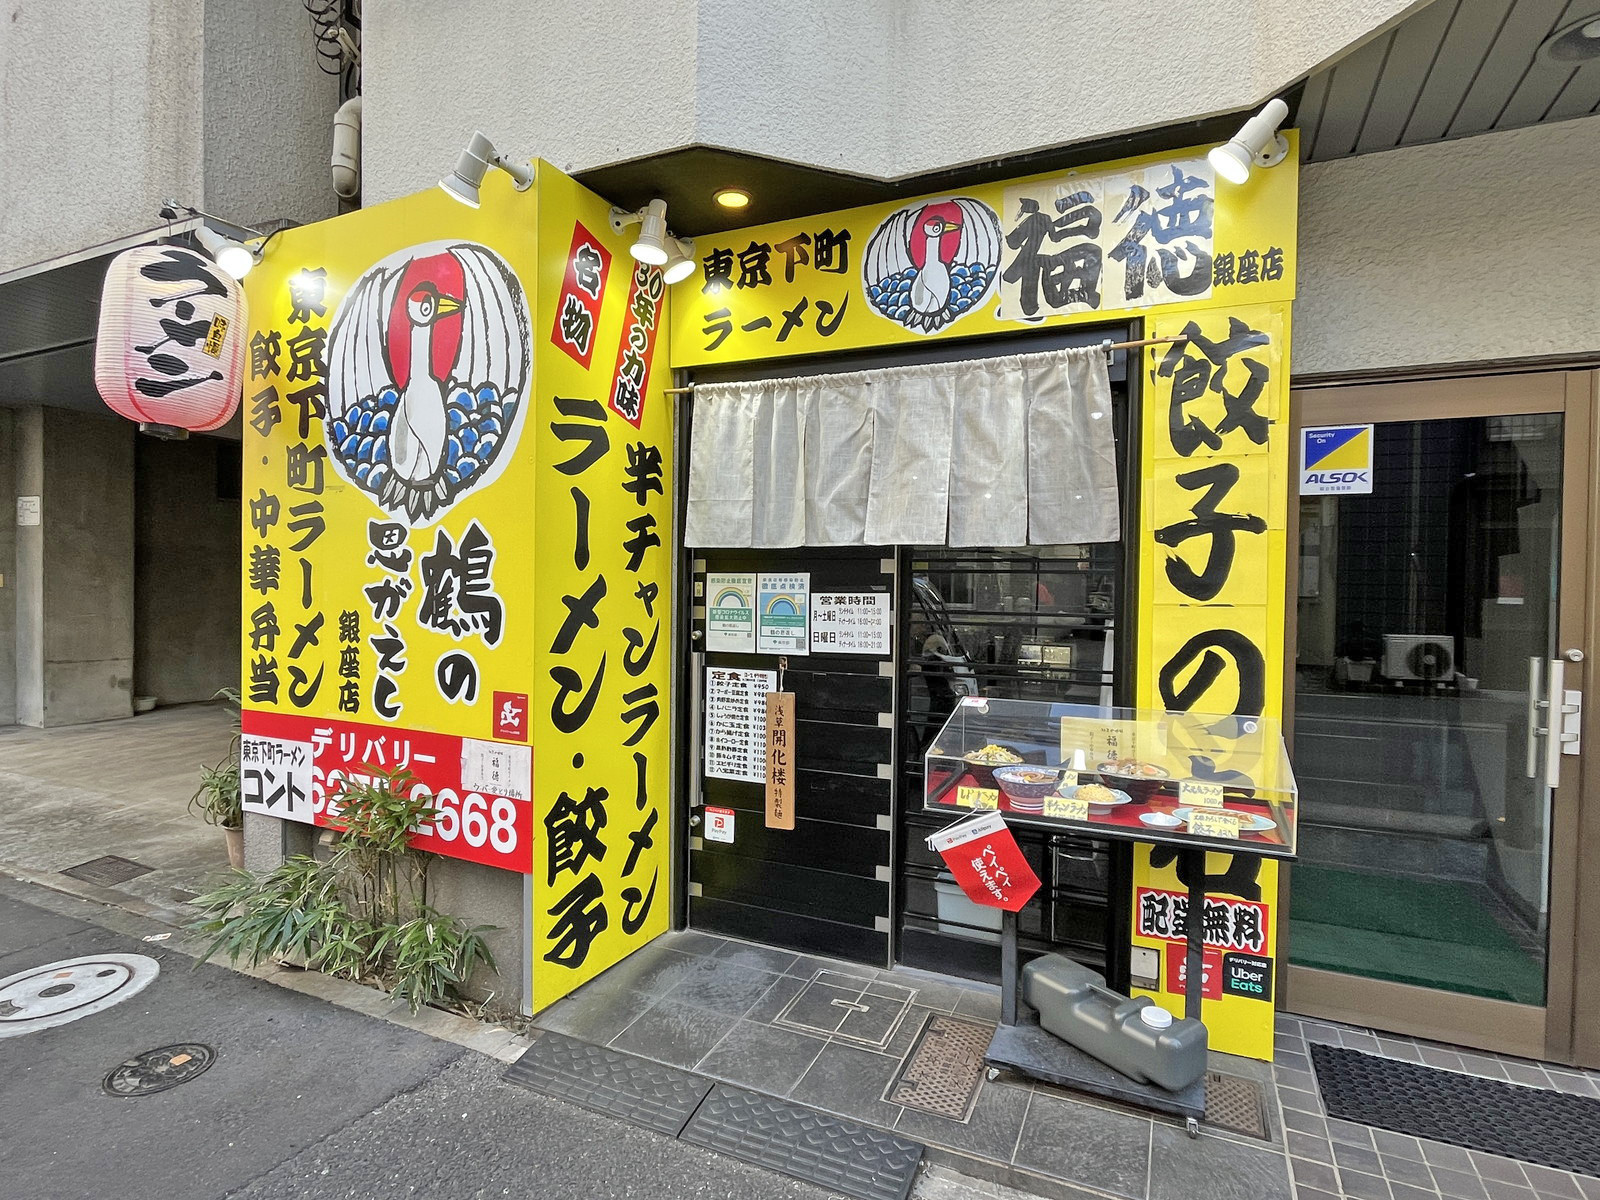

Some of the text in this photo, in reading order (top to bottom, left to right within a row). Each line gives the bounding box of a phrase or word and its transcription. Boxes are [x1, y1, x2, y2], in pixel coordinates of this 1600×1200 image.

[702, 228, 852, 295] 東京下町
[1000, 162, 1214, 317] 福徳
[1212, 246, 1285, 288] 銀座店
[560, 243, 603, 356] 名物
[701, 294, 849, 352] ラーメン
[286, 267, 327, 709] 東京下町ラーメン
[1304, 471, 1369, 485] ALSOK
[419, 518, 503, 704] 鶴の
[820, 595, 876, 606] 営業時間
[813, 631, 836, 643] 日曜日
[337, 609, 362, 717] 銀座店
[711, 670, 742, 681] 定食
[620, 440, 664, 936] 半チャンラーメン
[242, 739, 306, 768] 東京下町ラーメン
[310, 726, 438, 771] デリバリー
[243, 767, 306, 812] コント
[981, 844, 1012, 888] ペイペイ
[1231, 966, 1264, 982] Uber
[1231, 977, 1263, 994] Eats
